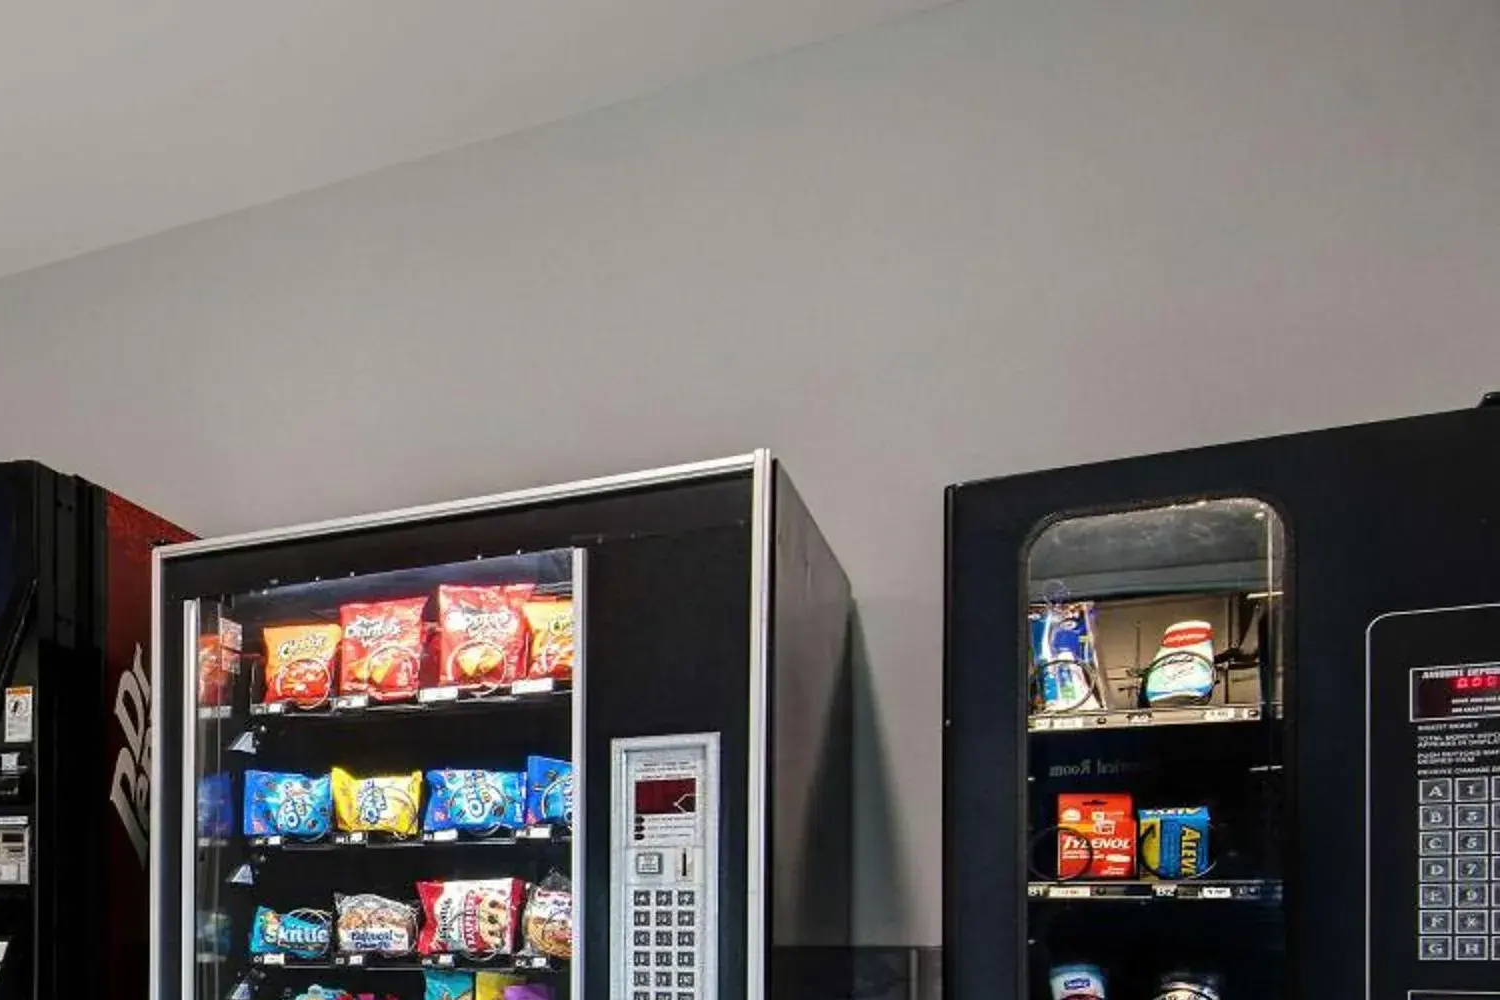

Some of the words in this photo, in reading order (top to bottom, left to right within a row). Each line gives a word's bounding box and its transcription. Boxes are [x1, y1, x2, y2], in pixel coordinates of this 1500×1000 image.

[1429, 785, 1443, 797] A
[1430, 811, 1443, 823] B
[1062, 835, 1132, 850] TYLENOL
[1428, 837, 1443, 849] C
[1430, 864, 1444, 875] D
[1466, 863, 1477, 875] 7
[1431, 916, 1444, 928] F
[265, 923, 331, 944] Skittle
[1428, 943, 1443, 955] G
[1464, 943, 1479, 955] H
